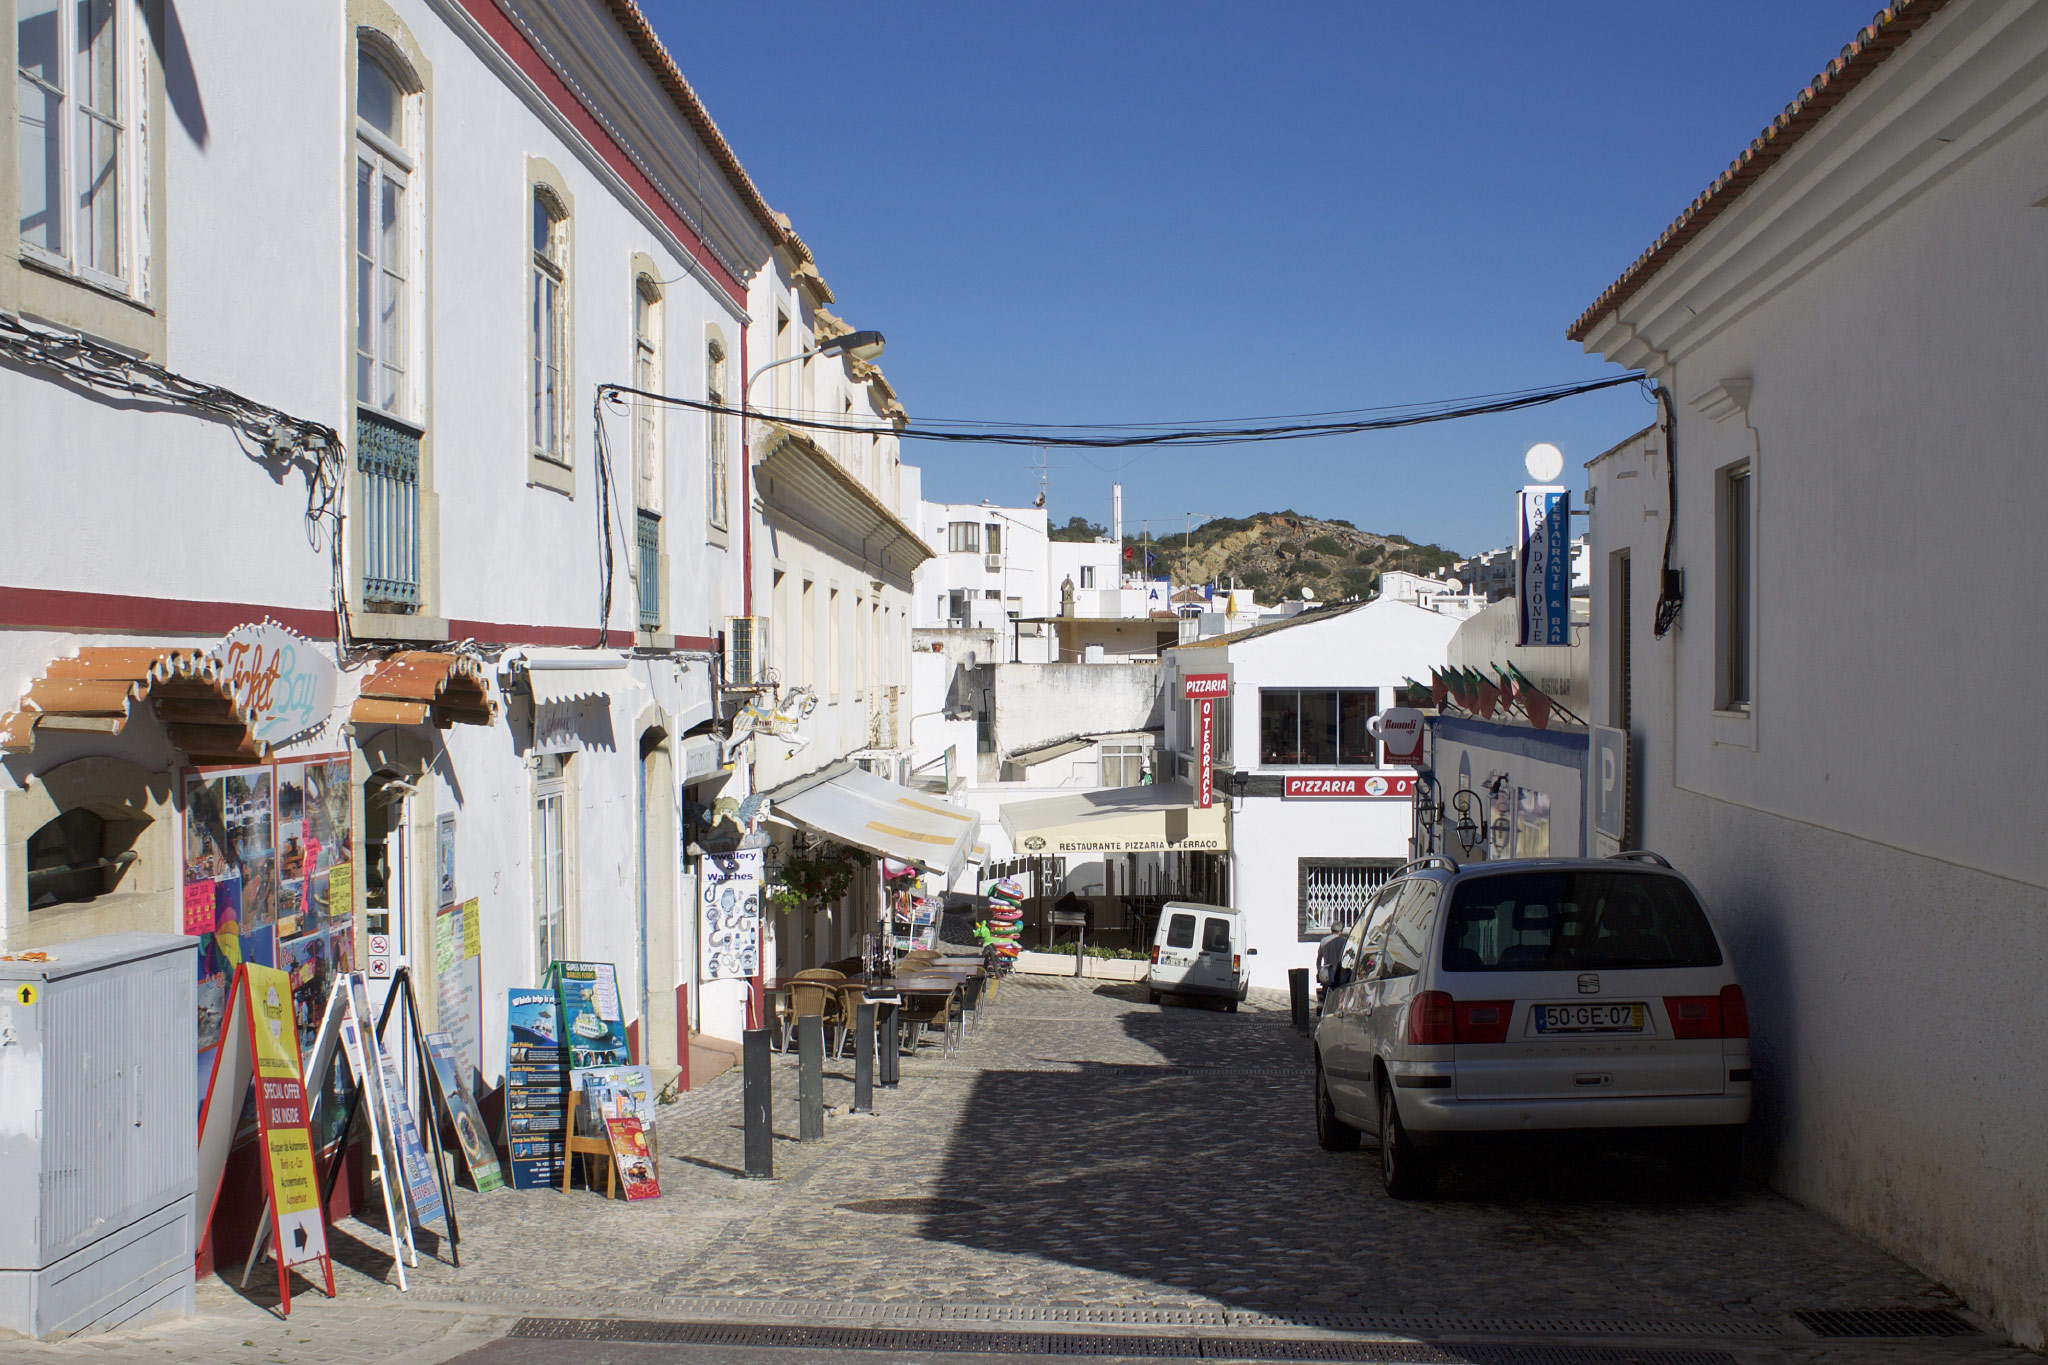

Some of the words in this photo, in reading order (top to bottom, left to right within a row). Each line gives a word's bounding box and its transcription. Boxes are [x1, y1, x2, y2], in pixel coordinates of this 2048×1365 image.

[1533, 495, 1543, 543] CASA
[1552, 496, 1561, 590] RESTAURANTE
[1533, 552, 1543, 574] DA
[1532, 582, 1543, 642] FONTE
[1551, 600, 1561, 608] &
[1552, 618, 1561, 642] BAR
[228, 641, 281, 712] Ticket
[277, 644, 318, 726] Bay
[1186, 679, 1227, 693] PIZZARIA
[1203, 702, 1211, 714] O
[1202, 717, 1211, 805] TERRAÇO
[1291, 780, 1355, 793] PIZZARIA
[1396, 780, 1406, 792] O
[1602, 746, 1615, 813] P
[1059, 842, 1121, 851] RESTAURANTE
[1125, 841, 1165, 850] PIZZARIA
[704, 851, 757, 861] Jewellery
[726, 862, 735, 870] &
[707, 873, 753, 881] Watches
[263, 1082, 284, 1099] SPECIAL
[284, 1083, 301, 1099] OFFER
[281, 1107, 300, 1123] INSIDE
